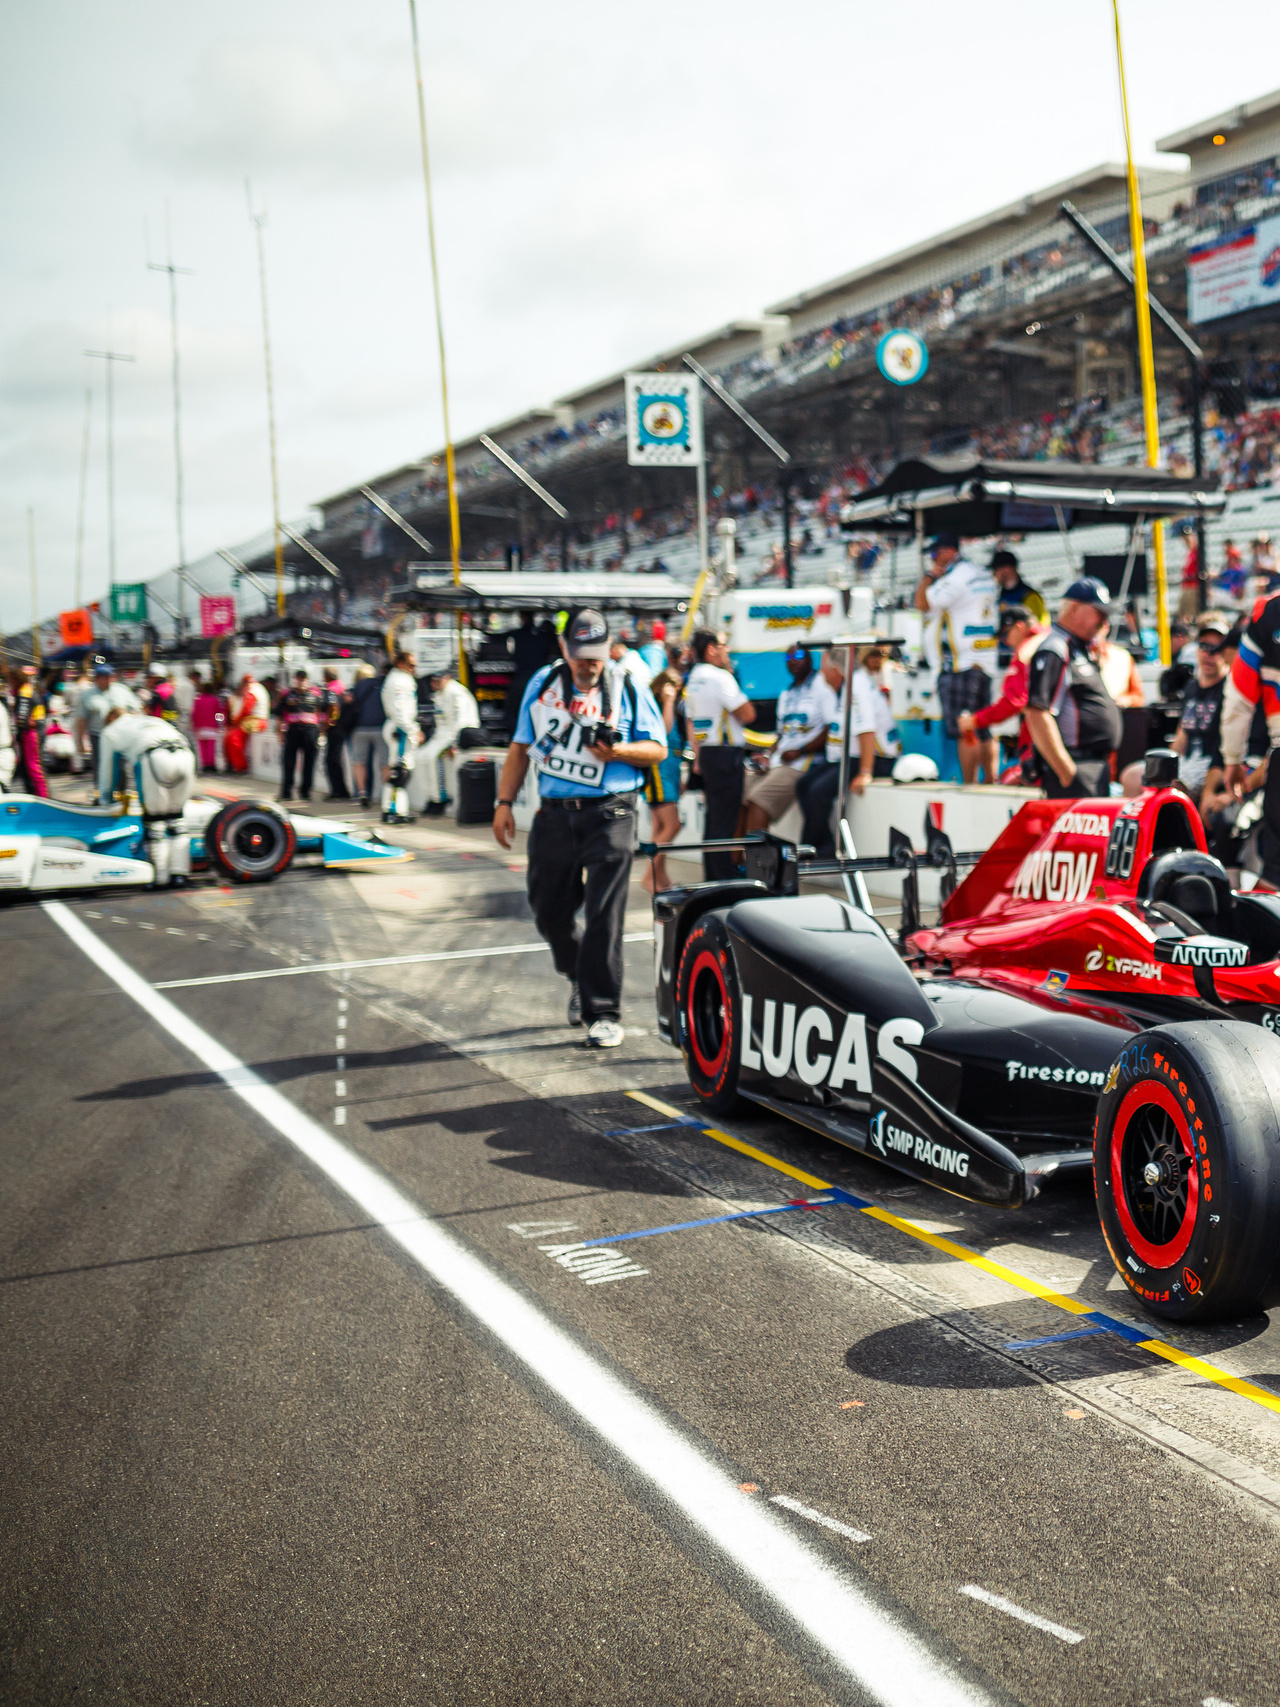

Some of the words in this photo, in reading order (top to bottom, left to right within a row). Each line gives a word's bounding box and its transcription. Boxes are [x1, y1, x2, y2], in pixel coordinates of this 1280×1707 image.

[1106, 955, 1163, 982] ZYPPAH
[1171, 945, 1249, 968] ARROW
[740, 993, 925, 1094] LUCAS
[1006, 1059, 1110, 1086] Fireston
[1152, 1051, 1213, 1203] Firestone
[885, 1124, 914, 1155] SMP
[914, 1136, 970, 1178] RACING
